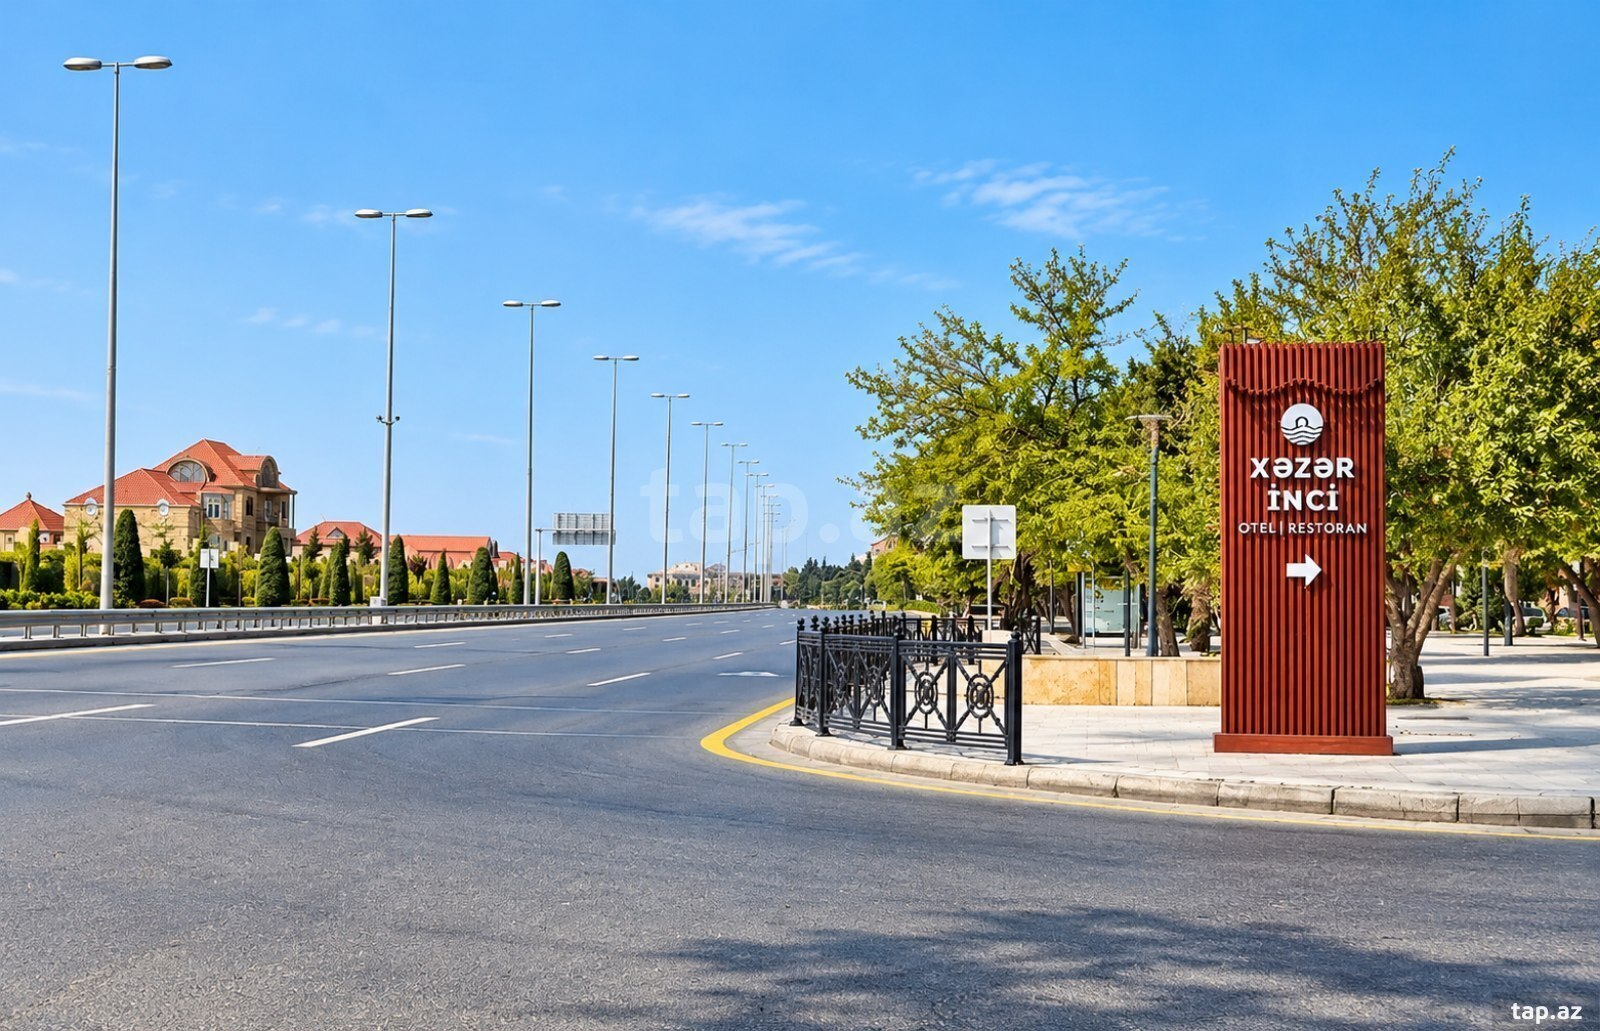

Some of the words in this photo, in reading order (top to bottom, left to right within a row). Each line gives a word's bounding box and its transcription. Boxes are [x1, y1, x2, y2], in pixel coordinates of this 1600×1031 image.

[1250, 457, 1355, 478] XƏZƏR
[1267, 483, 1339, 511] İNCİ
[1238, 522, 1276, 534] OTEL
[1288, 522, 1367, 534] RESTORAN
